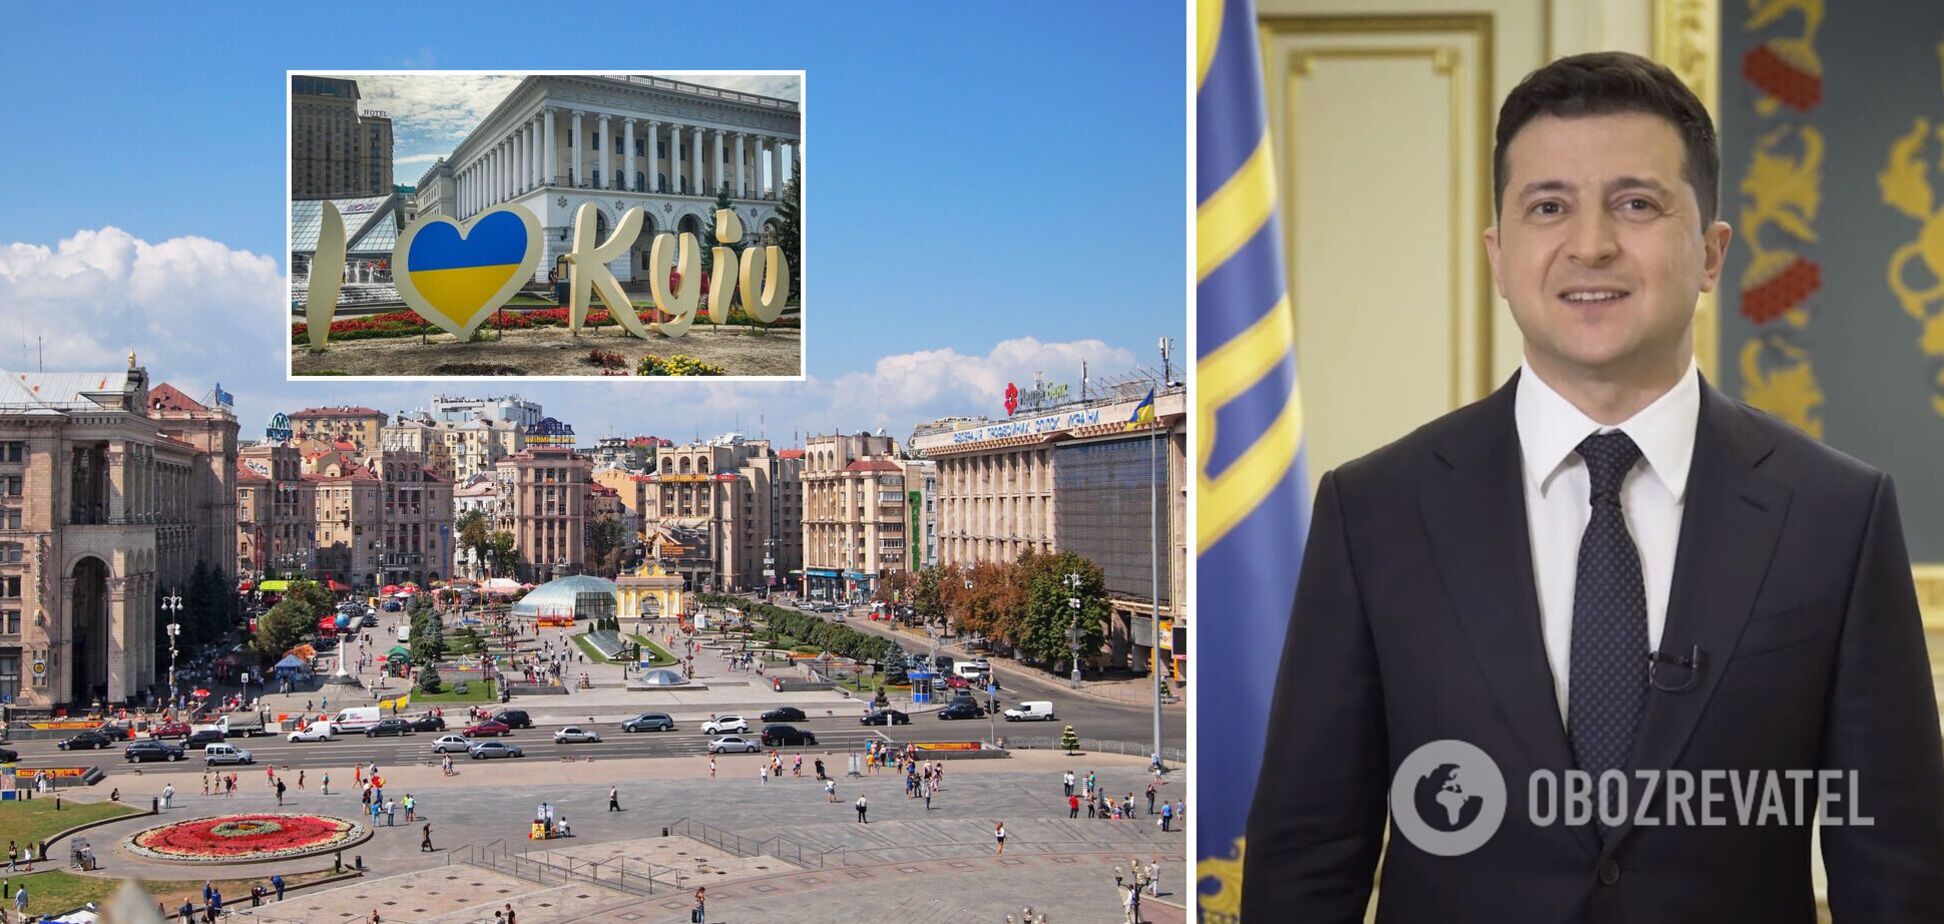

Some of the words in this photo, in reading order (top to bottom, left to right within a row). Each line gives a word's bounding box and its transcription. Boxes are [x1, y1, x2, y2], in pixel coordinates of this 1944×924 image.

[364, 109, 388, 117] HOTEL
[305, 199, 347, 352] I
[565, 202, 789, 340] Kyiv
